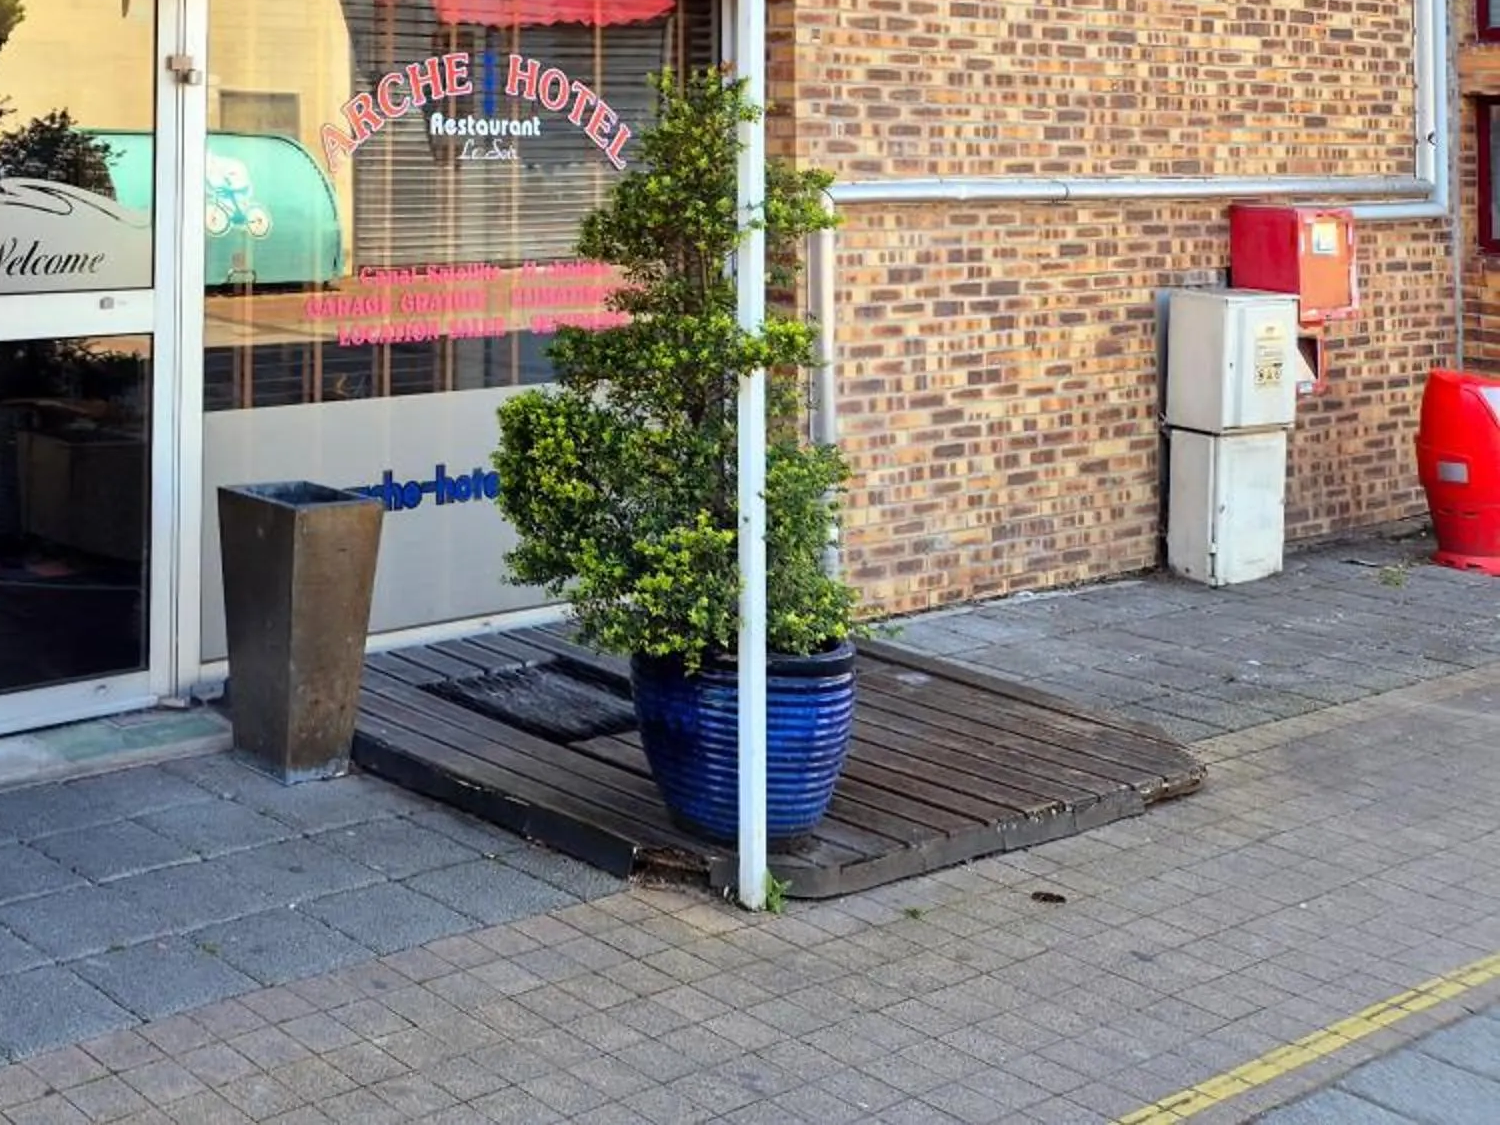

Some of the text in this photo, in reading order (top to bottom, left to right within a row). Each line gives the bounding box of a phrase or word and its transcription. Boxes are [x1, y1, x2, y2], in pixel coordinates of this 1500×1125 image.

[320, 52, 632, 175] ARCHE HOTEL
[430, 112, 541, 135] Restaurant
